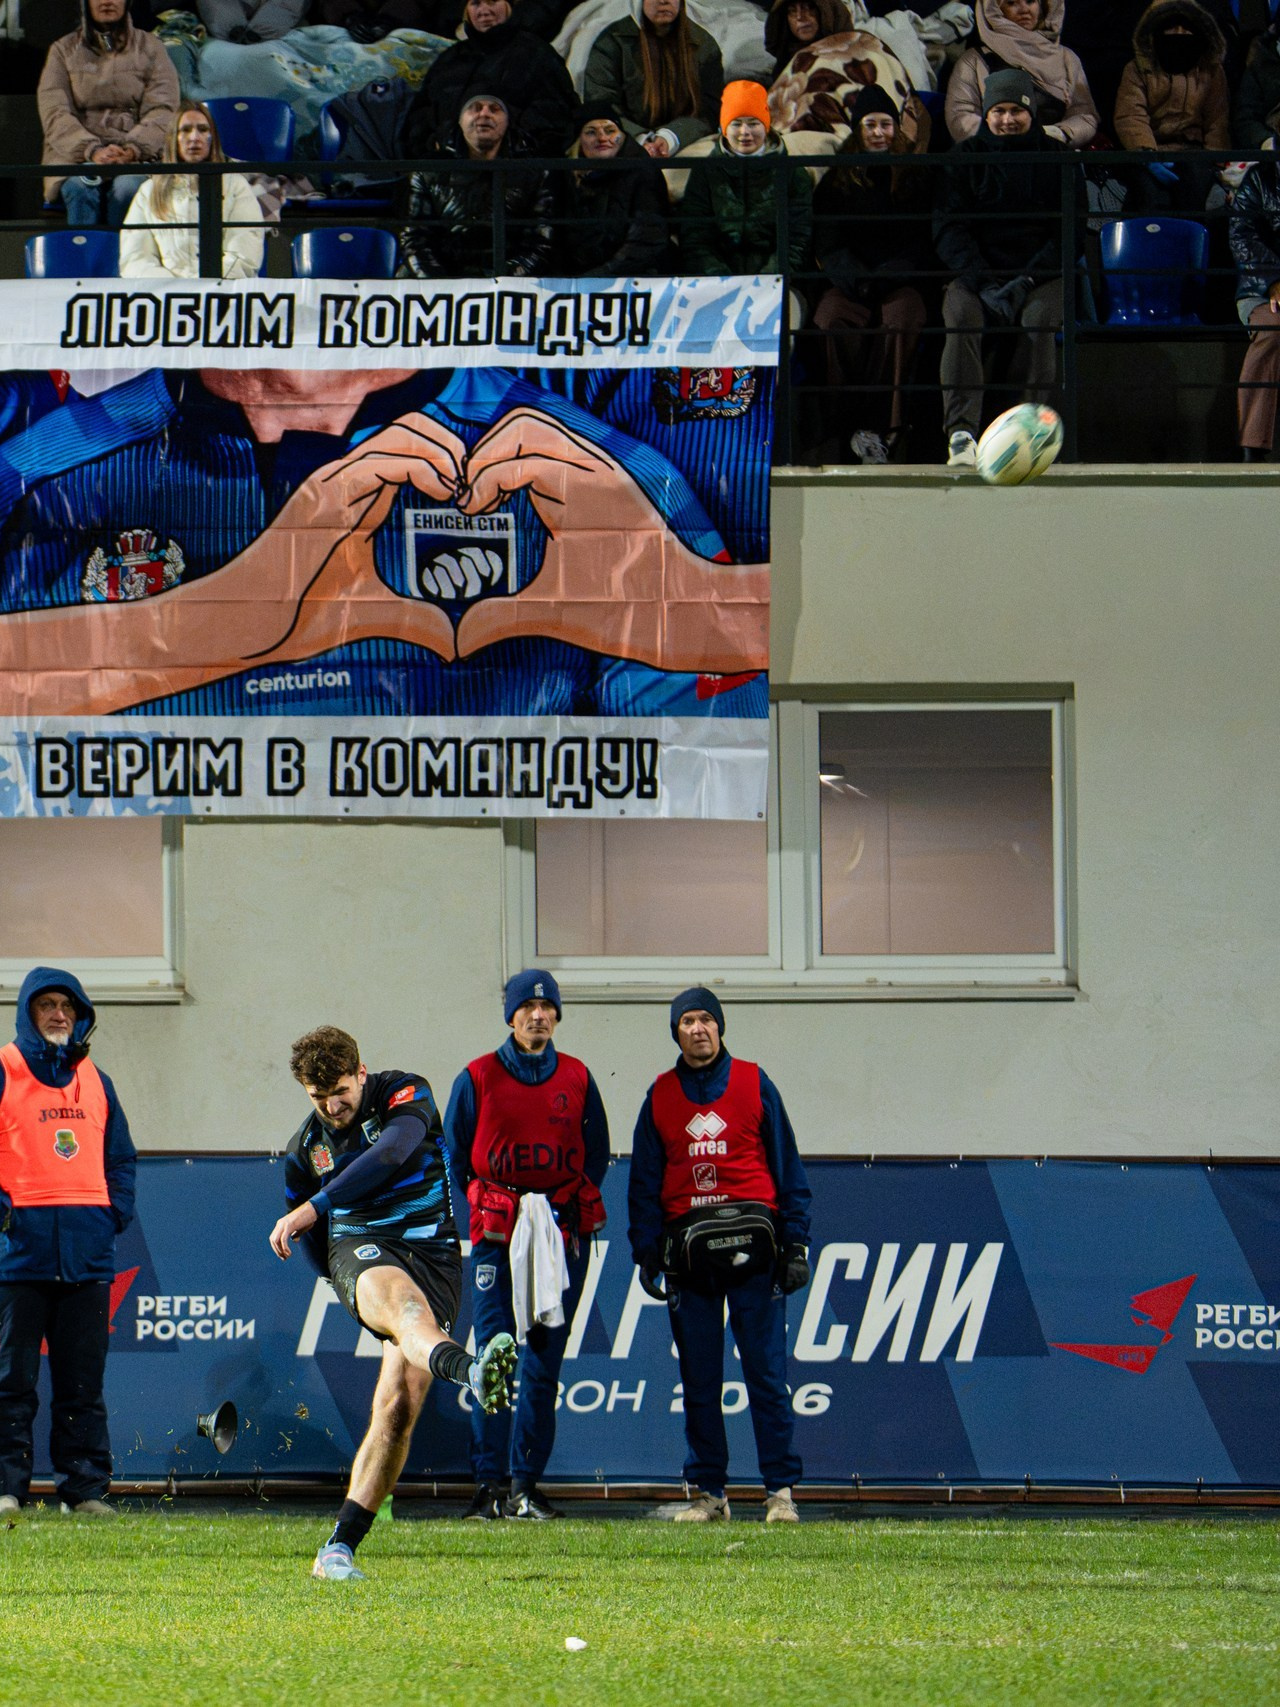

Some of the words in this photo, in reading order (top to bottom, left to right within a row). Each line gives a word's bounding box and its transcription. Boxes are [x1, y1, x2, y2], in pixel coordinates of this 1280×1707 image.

[60, 292, 296, 348] ЛЮБИМ
[318, 291, 652, 356] КОМАНДУ!
[477, 516, 509, 532] СТМ
[245, 668, 351, 695] centurion
[35, 736, 243, 798] ВЕРИМ
[266, 736, 305, 796] В
[329, 736, 658, 810] КОМАНДУ!
[488, 1144, 578, 1177] MEDIC
[137, 1295, 227, 1316] РЕГБИ
[610, 1242, 1004, 1362] РСИИ
[135, 1319, 255, 1340] РОССИИ
